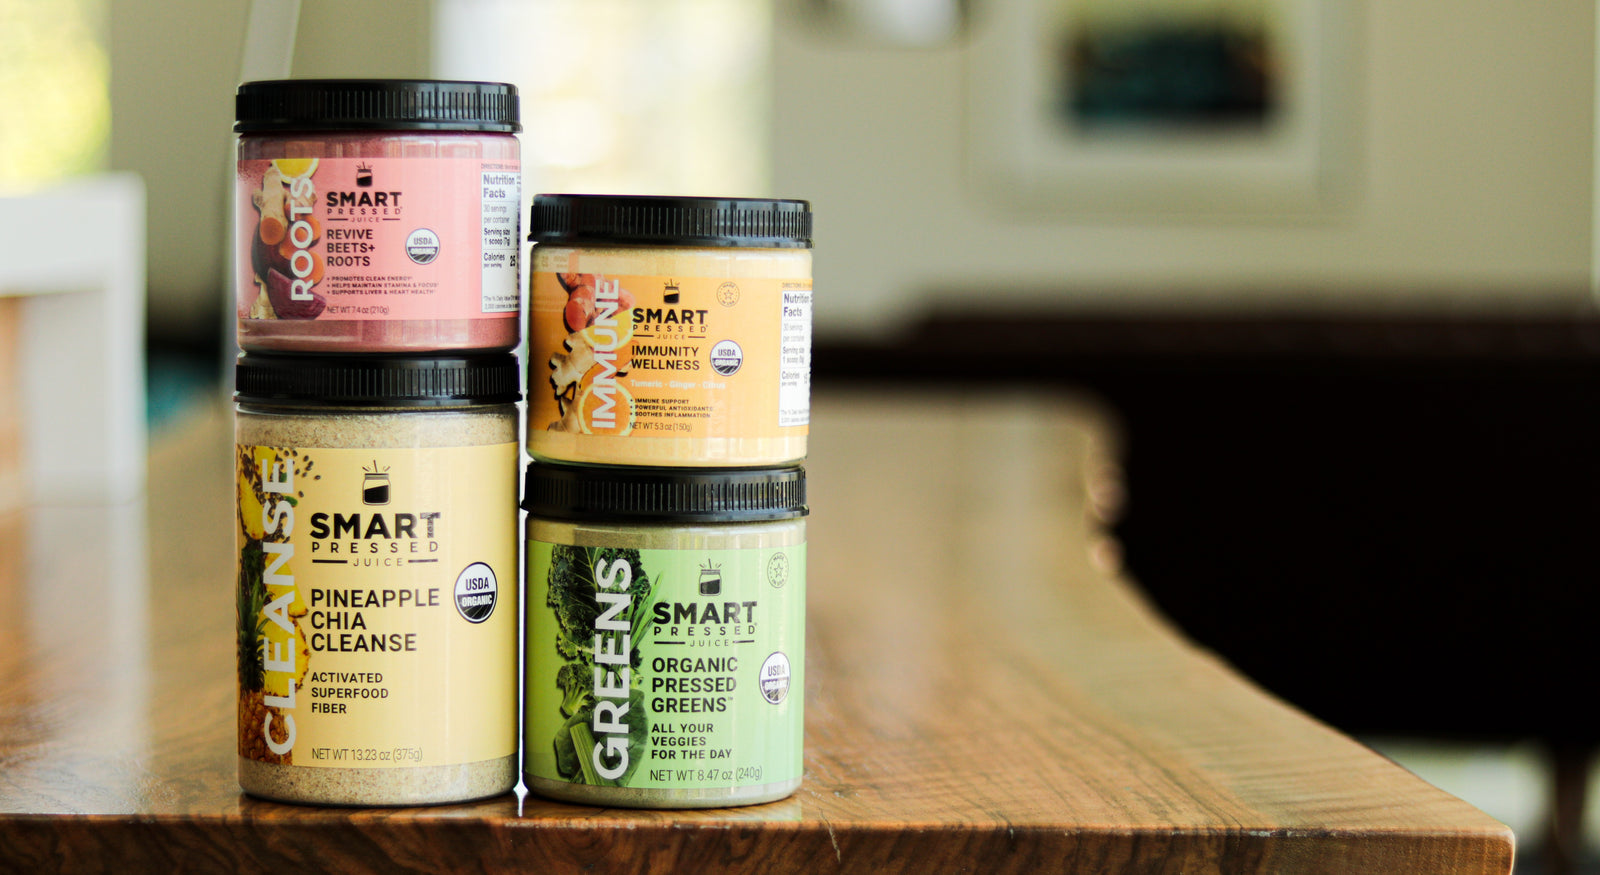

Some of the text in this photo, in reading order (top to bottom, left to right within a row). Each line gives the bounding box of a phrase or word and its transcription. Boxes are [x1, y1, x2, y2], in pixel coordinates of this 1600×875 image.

[483, 174, 515, 185] Nutrition
[326, 191, 402, 207] SMART
[483, 187, 506, 199] Facts
[326, 229, 374, 239] REVIVE
[484, 227, 502, 237] Serving
[291, 176, 314, 302] ROOTS
[413, 237, 433, 246] USDA
[326, 242, 375, 253] BEETS+
[326, 256, 371, 267] ROOTS
[484, 252, 516, 267] Calories 25
[783, 293, 809, 304] Nutrition
[369, 305, 389, 315] (210g)
[632, 308, 708, 324] SMART
[783, 306, 802, 317] Facts
[632, 324, 707, 333] PRESSED
[591, 279, 620, 429] IMMUNE
[631, 345, 700, 357] IMMUNITY
[631, 358, 700, 371] WELLNESS
[782, 371, 800, 380] Calories
[630, 379, 663, 388] Tumeric
[669, 380, 696, 390] Ginger
[629, 422, 641, 430] NET
[643, 422, 653, 430] WT
[673, 422, 693, 432] (150g)
[309, 511, 441, 540] SMART
[311, 541, 438, 554] PRESSED
[353, 557, 404, 567] JUICE
[465, 577, 490, 591] USDA
[310, 588, 440, 608] PINEAPPLE
[461, 594, 493, 607] ORGANIC
[262, 458, 297, 756] CLEANSE
[652, 601, 758, 625] SMART
[310, 611, 367, 630] CHIA
[653, 625, 756, 636] PRESSED
[310, 633, 418, 652] CLEANSE
[690, 639, 729, 647] JUICE
[592, 557, 633, 781] GREENS
[652, 657, 738, 673] ORGANIC
[767, 664, 786, 677] USDA
[311, 672, 384, 683] ACTIVATED
[652, 677, 737, 693] PRESSED
[311, 687, 389, 699] SUPERFOOD
[311, 702, 347, 714] FIBER
[651, 723, 714, 733] ALL YOUR
[651, 736, 707, 746] VEGGIES
[311, 747, 423, 763] NET WT 13.23 oz (375g)
[651, 748, 732, 759] FOR THE DAY
[650, 765, 763, 782] NET WT 8.47 oz (240g)
